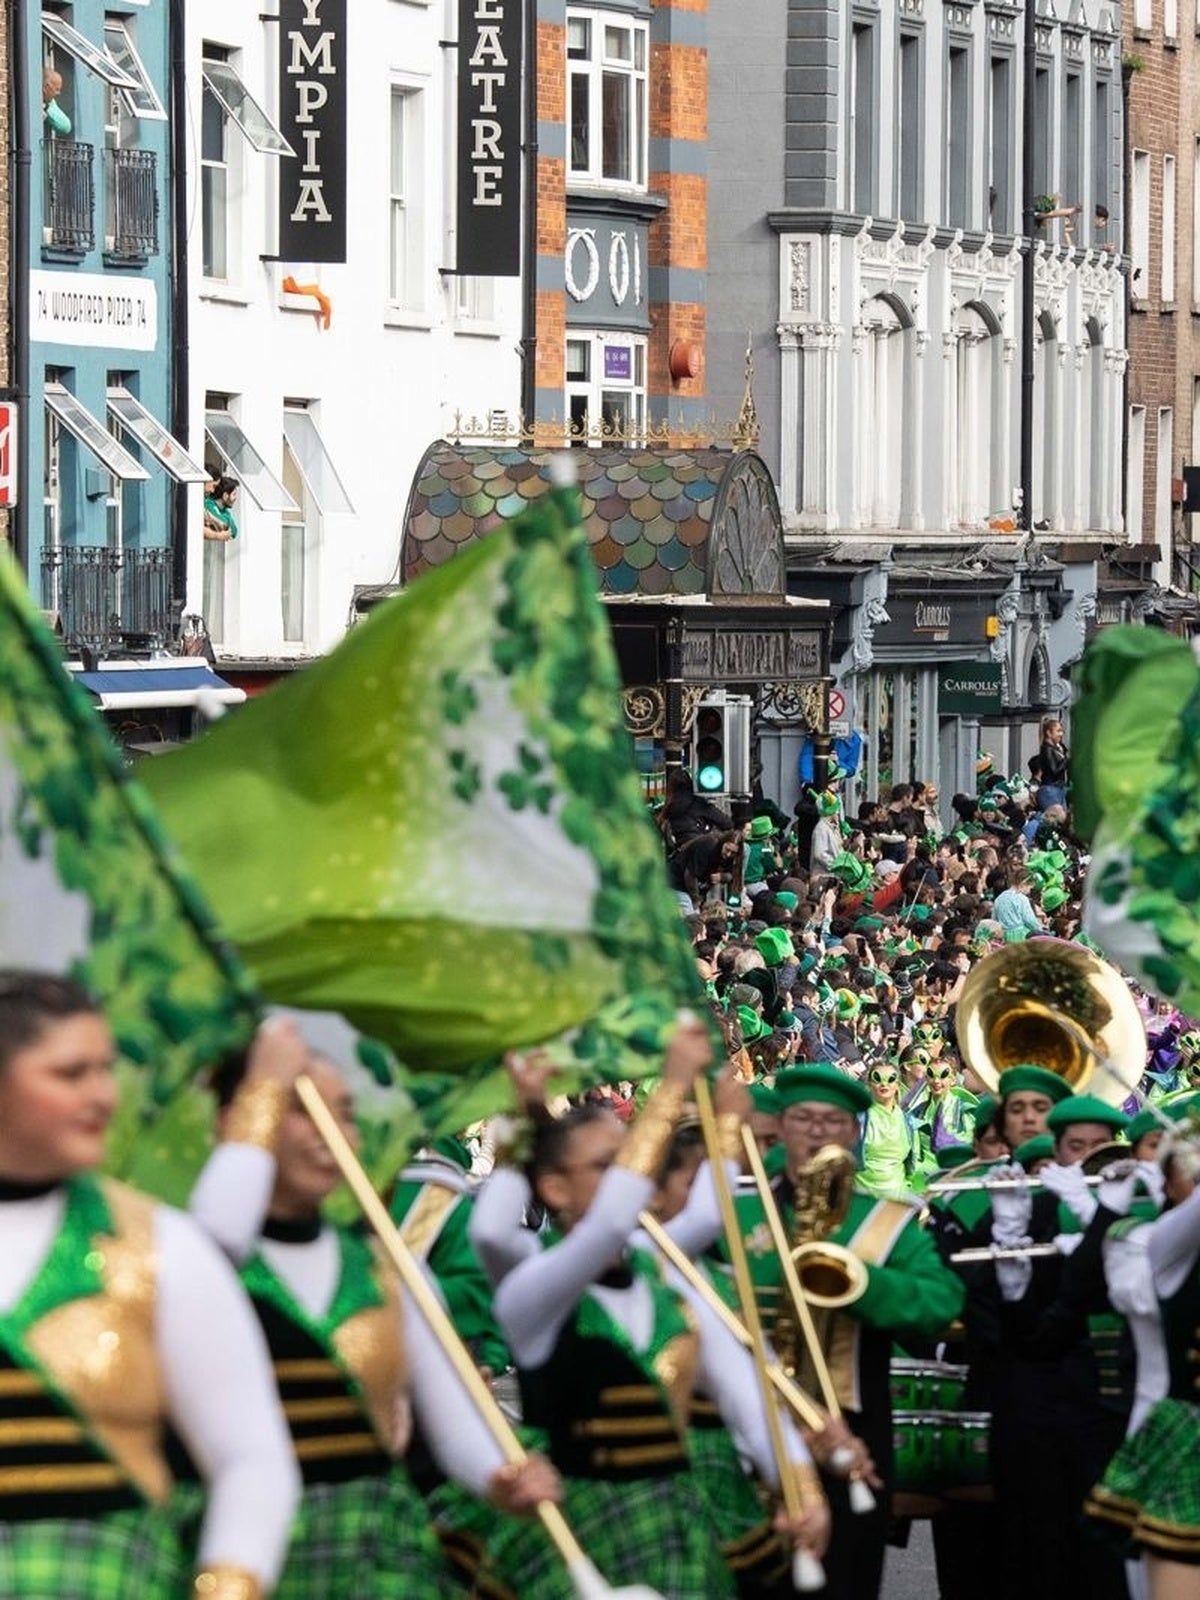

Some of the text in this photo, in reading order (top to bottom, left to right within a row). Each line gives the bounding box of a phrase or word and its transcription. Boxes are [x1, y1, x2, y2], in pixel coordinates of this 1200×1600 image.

[287, 0, 336, 222] YMPIA
[38, 289, 146, 328] 74 WOODFIRED PIZZA 74
[944, 679, 999, 691] CARROLLS
